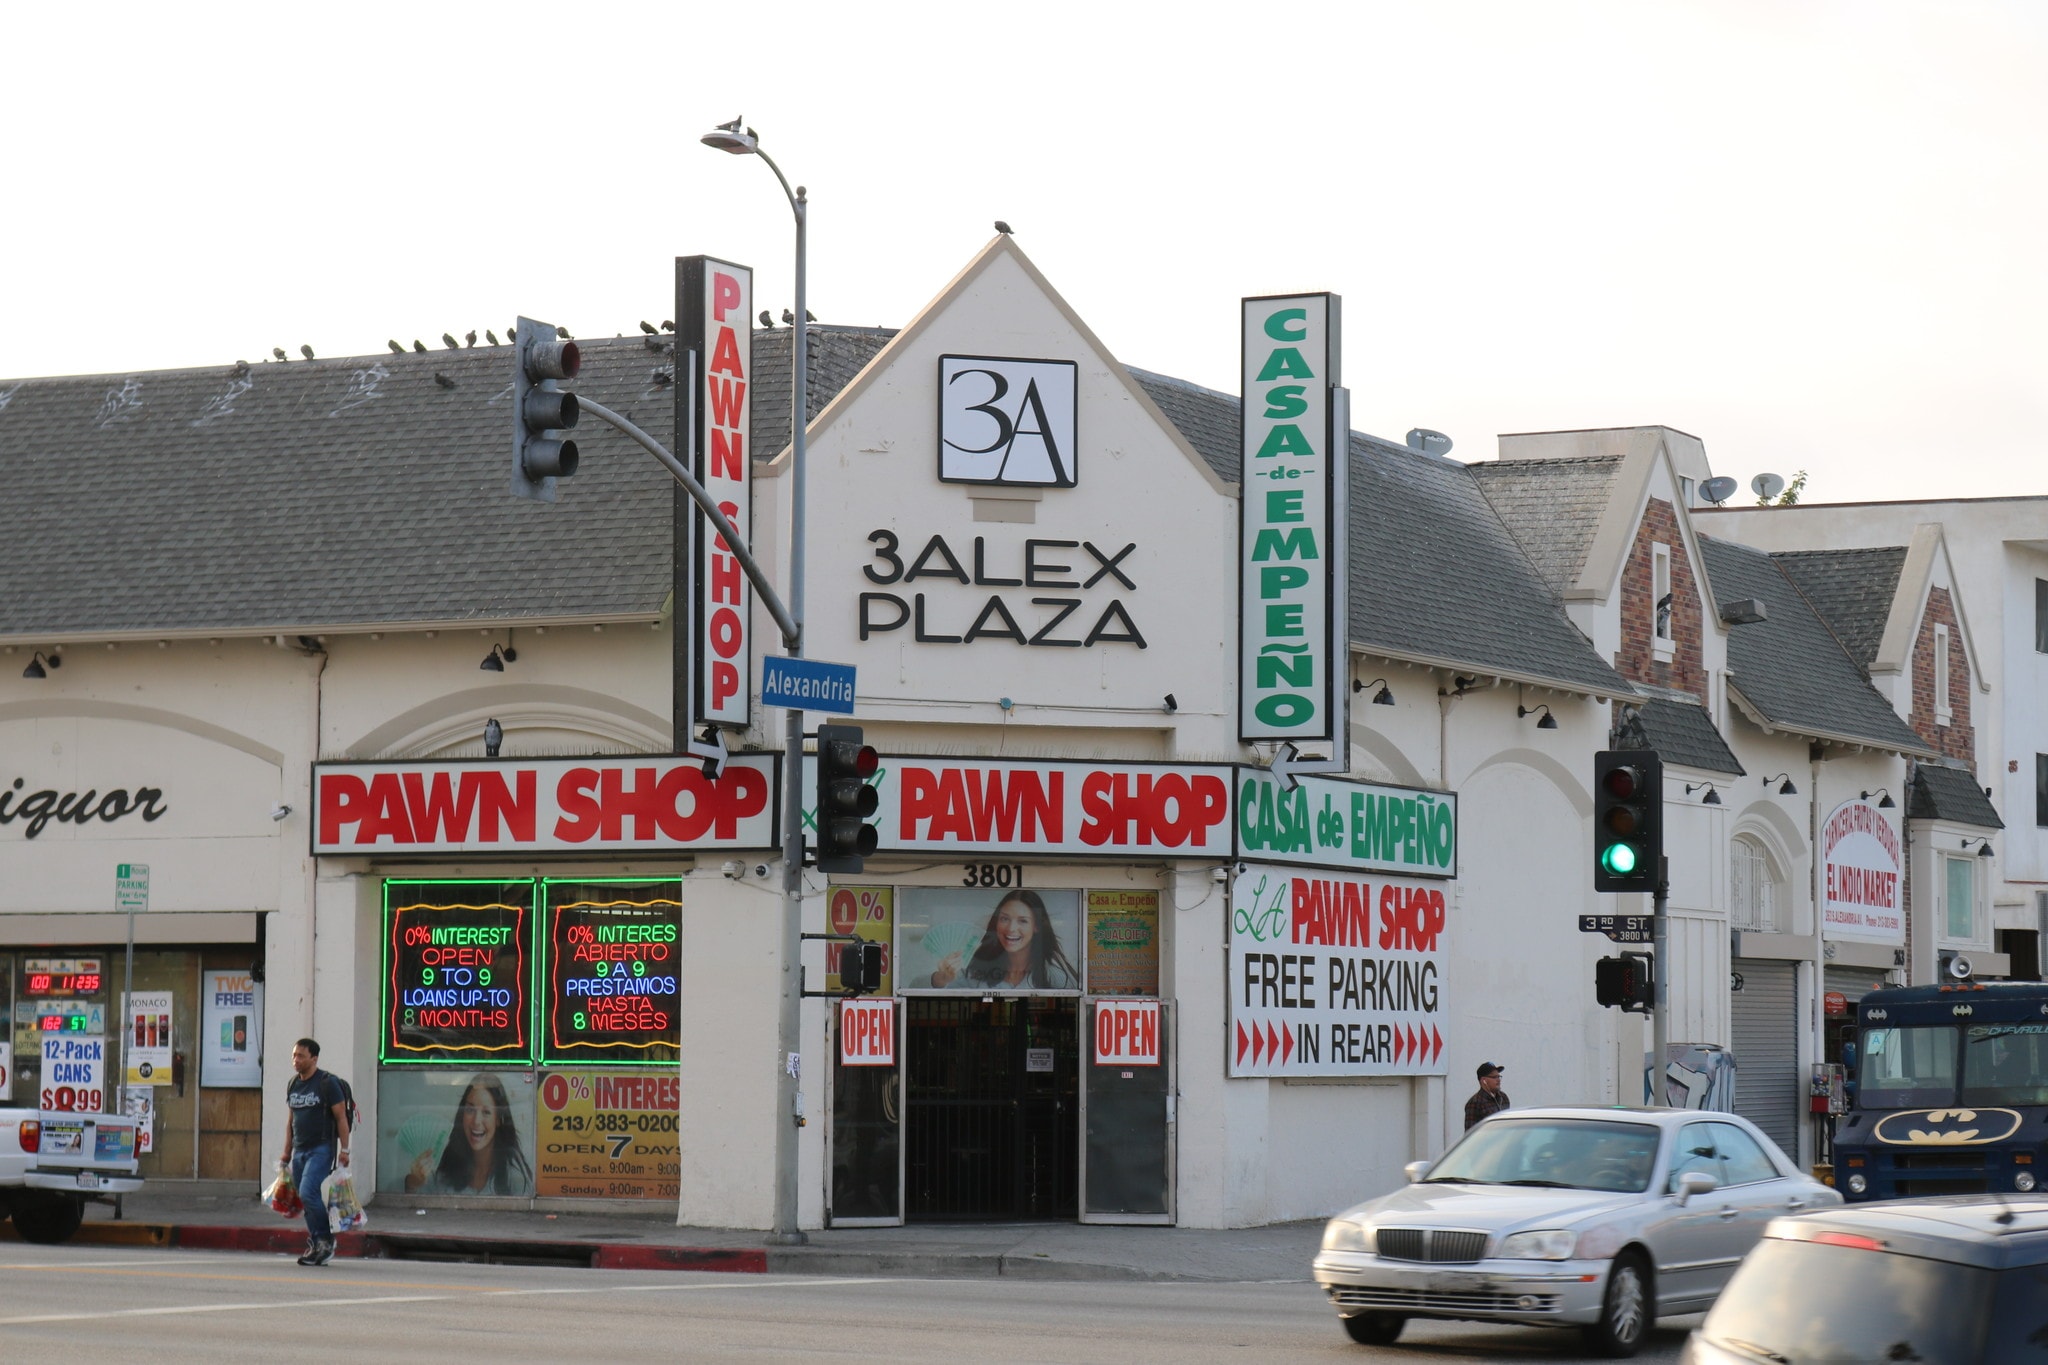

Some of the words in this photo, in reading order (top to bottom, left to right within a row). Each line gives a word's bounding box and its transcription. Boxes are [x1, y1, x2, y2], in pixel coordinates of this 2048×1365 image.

[708, 271, 746, 482] PAWN
[1256, 308, 1315, 458] CASA
[944, 369, 1075, 487] 3A
[862, 529, 1137, 591] 3ALEX
[709, 500, 743, 710] SHOP
[1251, 489, 1319, 728] EMPEÑO
[859, 592, 1148, 649] PLAZA
[766, 669, 853, 703] Alexandria
[319, 770, 537, 845] PAWN
[553, 766, 768, 843] SHOP
[900, 767, 1064, 844] PAWN
[1079, 771, 1228, 849] SHOP
[1239, 778, 1313, 854] CASA
[1317, 793, 1345, 849] de
[1351, 791, 1453, 868] EMPEÑO
[117, 880, 148, 891] PARKING
[963, 864, 1023, 888] 3801
[1827, 863, 1838, 901] EL
[1839, 865, 1862, 904] INDIO
[1864, 869, 1897, 909] MARKET
[1088, 893, 1109, 905] Casa
[1119, 893, 1156, 908] Empeño
[1234, 874, 1287, 942] LA
[1292, 877, 1371, 948] PAWN
[1379, 884, 1446, 952] SHOP
[405, 926, 431, 946] 0%
[432, 927, 512, 945] INTEREST
[568, 925, 594, 944] 0%
[598, 924, 677, 943] INTERES
[1620, 931, 1640, 941] 3800
[422, 948, 493, 966] OPEN
[574, 943, 669, 962] ABIERTO
[422, 968, 434, 986] 9
[441, 968, 472, 986] TO
[479, 968, 491, 987] 9
[596, 961, 608, 977] 9
[612, 961, 628, 977] A
[634, 961, 646, 977] 9
[31, 975, 50, 989] 100
[566, 976, 676, 997] PRESTAMOS
[1245, 953, 1316, 1008] FREE
[1329, 957, 1438, 1013] PARKING
[215, 992, 253, 1006] FREE
[404, 989, 457, 1007] LOANS
[461, 988, 511, 1007] UP-TO
[588, 996, 654, 1012] HASTA
[43, 1016, 62, 1031] 162
[71, 1016, 87, 1030] 57
[91, 1009, 101, 1023] A
[404, 1008, 415, 1027] 8
[420, 1010, 509, 1028] MONTHS
[573, 1012, 586, 1030] 8
[591, 1012, 668, 1030] MESES
[843, 1007, 891, 1057] OPEN
[1098, 1008, 1156, 1057] OPEN
[1871, 1030, 1881, 1044] A
[44, 1040, 102, 1060] 12-Pack
[1298, 1023, 1320, 1063] IN
[1332, 1024, 1392, 1064] REAR
[53, 1063, 92, 1083] CANS
[543, 1074, 590, 1112] 0%
[595, 1076, 680, 1111] INTERES
[546, 1144, 605, 1154] OPEN
[606, 1135, 633, 1159] 7
[543, 1164, 570, 1173] Mon.
[582, 1164, 605, 1174] Sat.
[609, 1162, 645, 1174] 9:00am
[560, 1184, 605, 1196] Sunday
[609, 1183, 645, 1194] 9:00am
